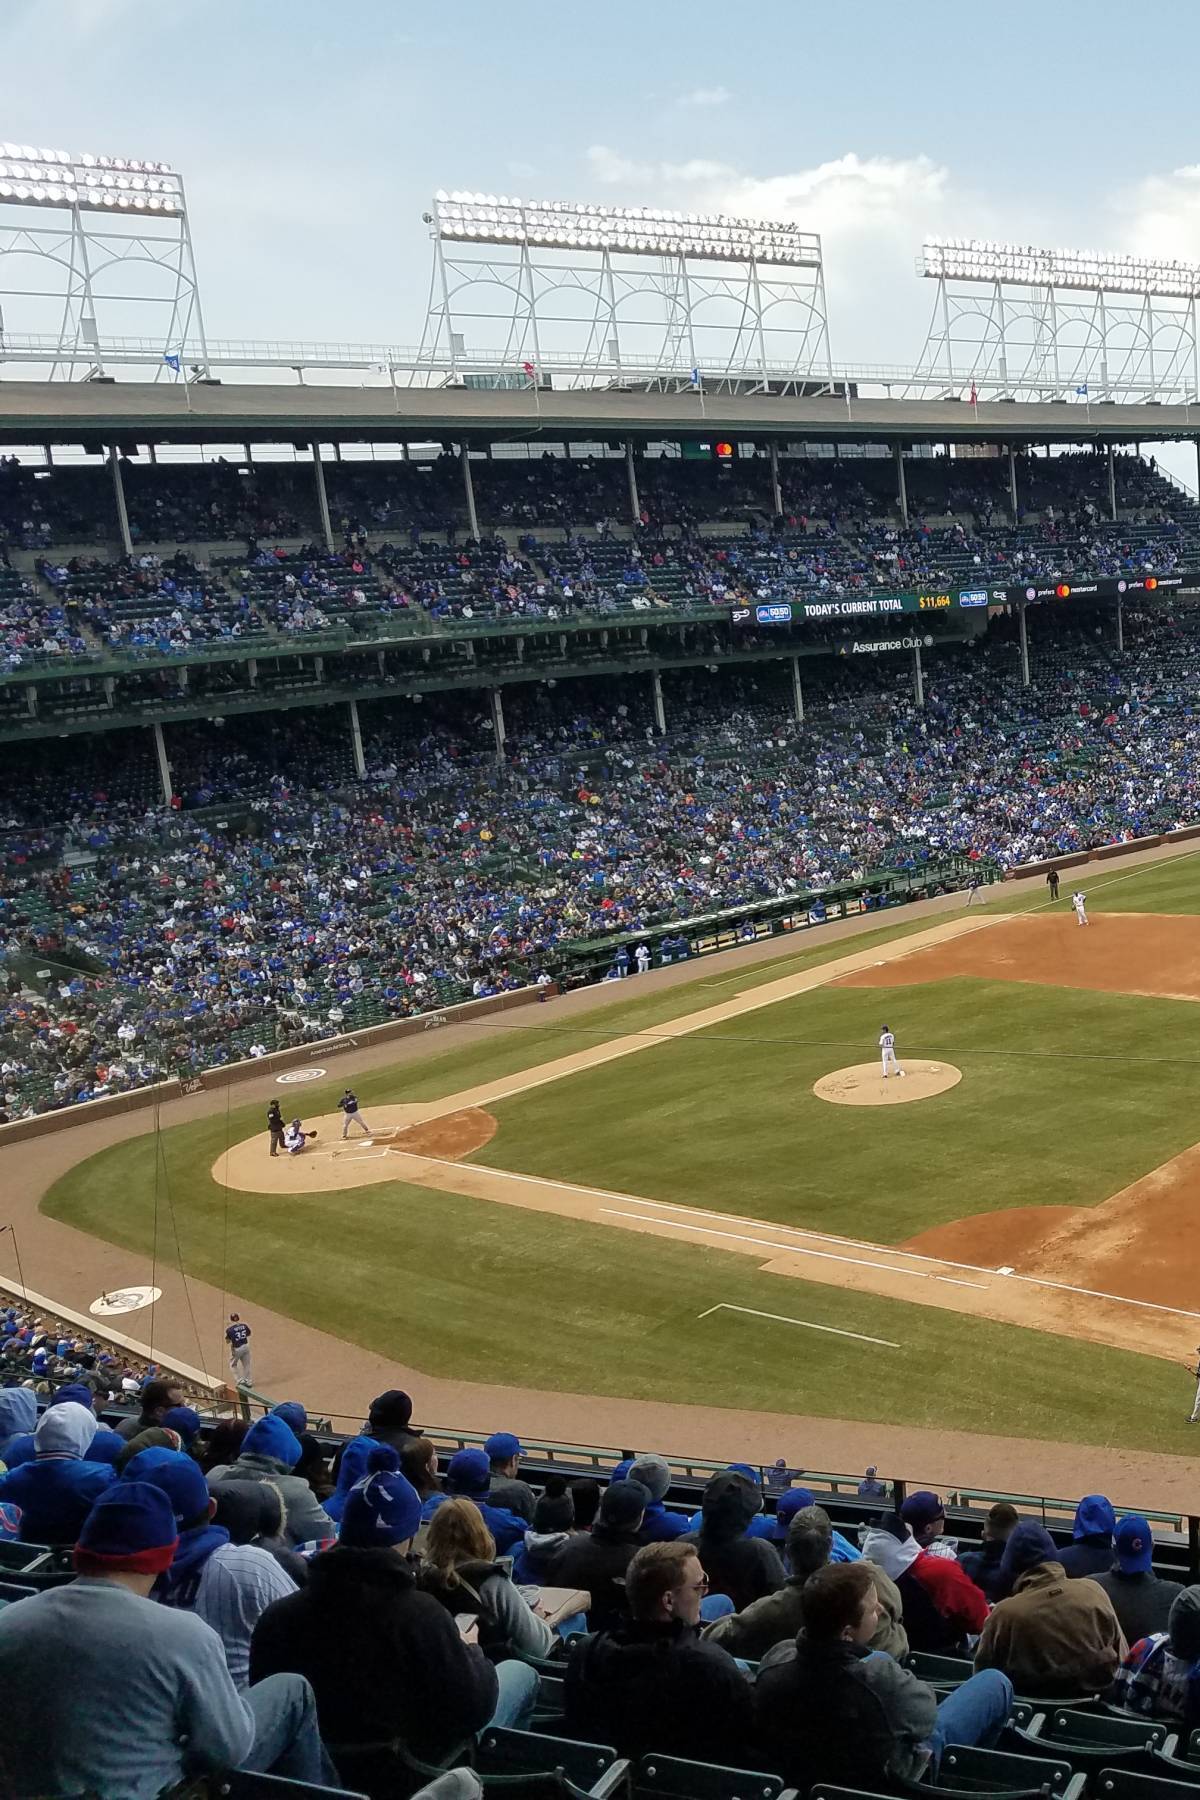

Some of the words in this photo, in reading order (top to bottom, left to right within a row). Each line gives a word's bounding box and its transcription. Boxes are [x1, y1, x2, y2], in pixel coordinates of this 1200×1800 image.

[804, 603, 840, 616] TODAY'S
[841, 601, 877, 613] CURRENT
[879, 599, 903, 611] TOTAL
[852, 640, 901, 654] Assurance
[902, 637, 922, 648] Club
[234, 1330, 247, 1341] 35
